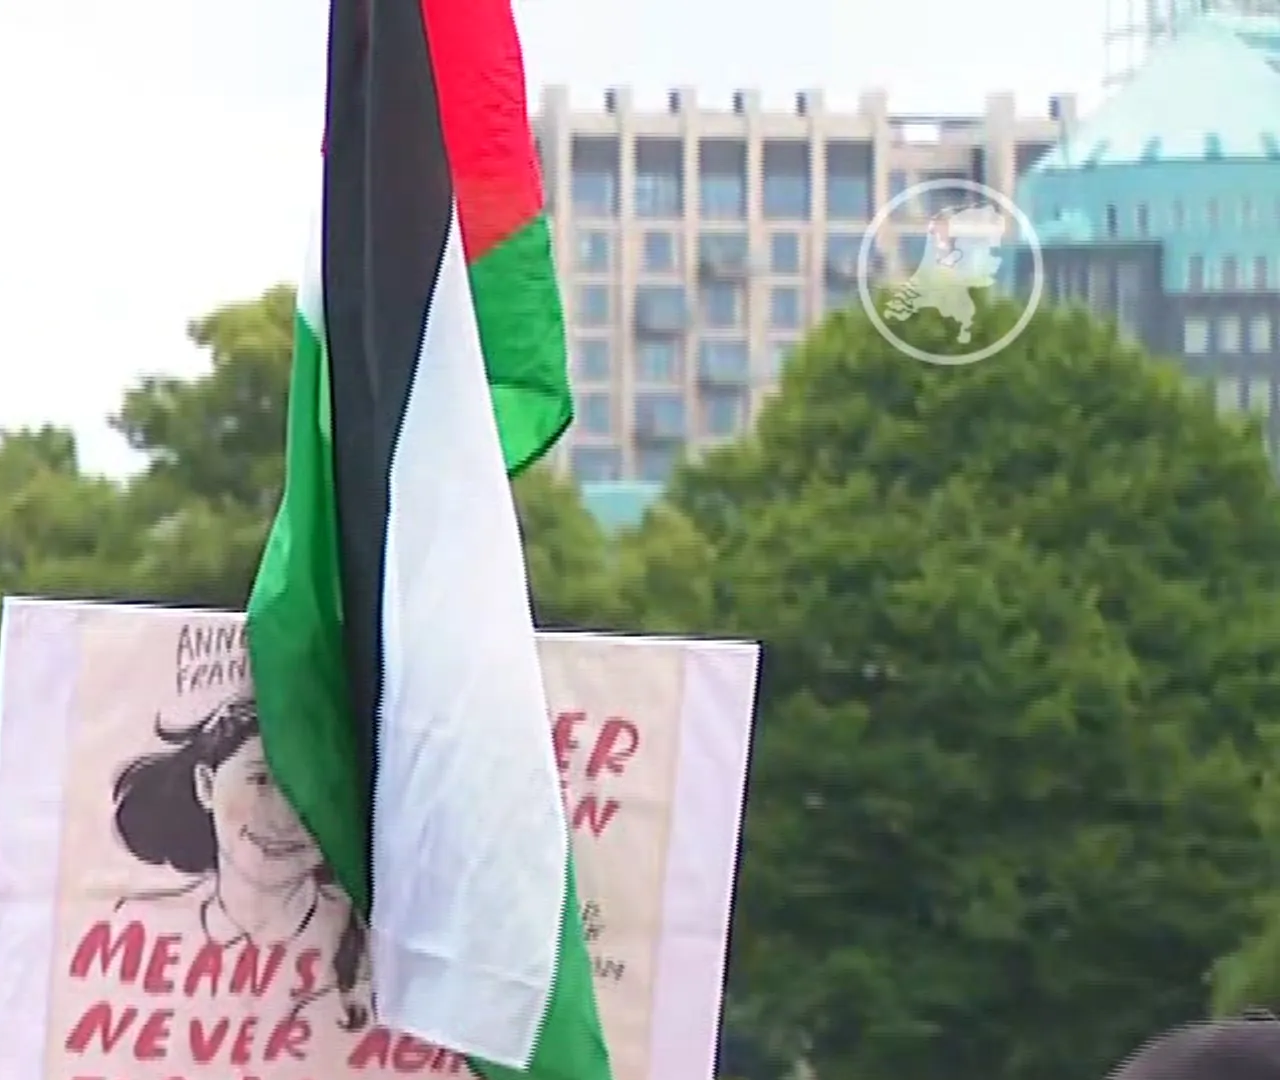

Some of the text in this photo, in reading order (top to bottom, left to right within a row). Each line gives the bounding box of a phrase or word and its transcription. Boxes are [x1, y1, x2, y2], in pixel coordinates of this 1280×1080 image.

[175, 656, 248, 697] FRAN
[68, 918, 322, 999] MEANS
[64, 1000, 312, 1064] NEVER
